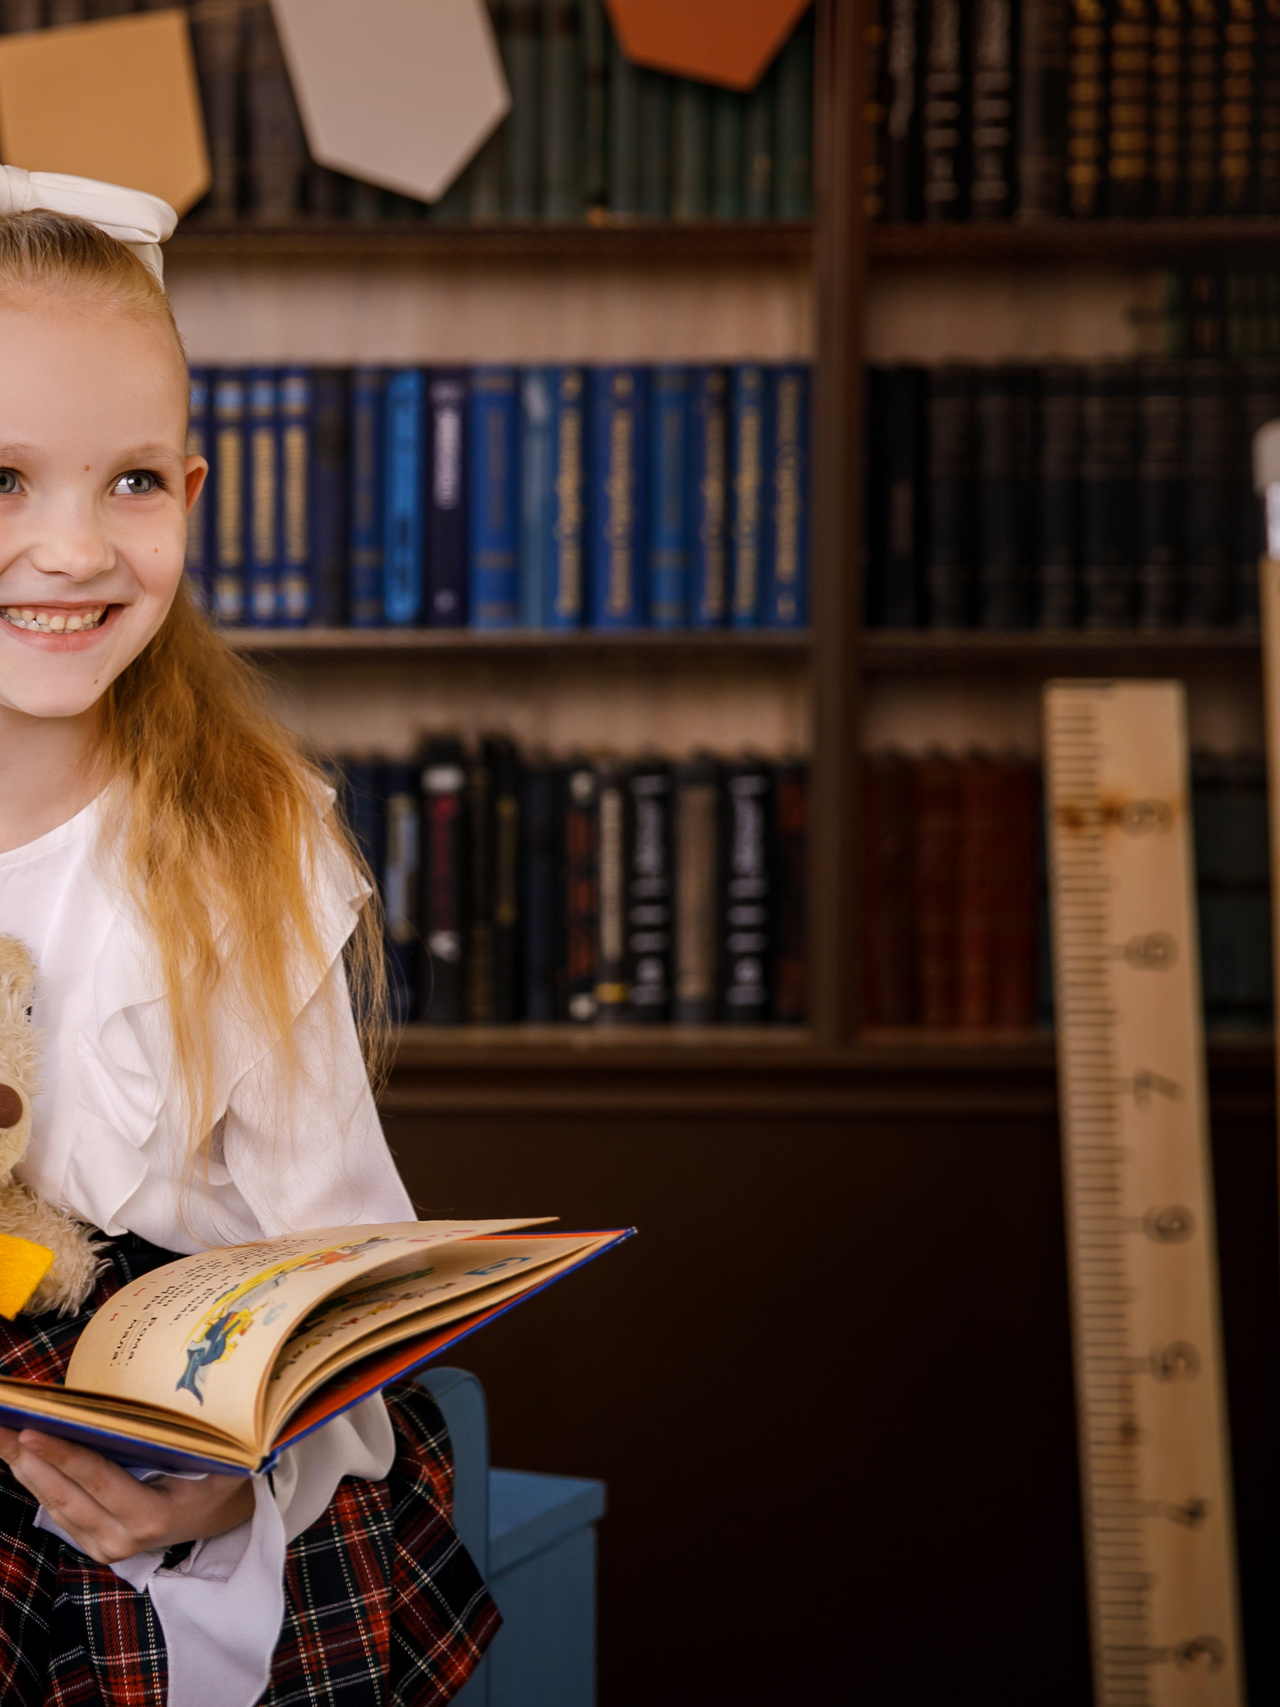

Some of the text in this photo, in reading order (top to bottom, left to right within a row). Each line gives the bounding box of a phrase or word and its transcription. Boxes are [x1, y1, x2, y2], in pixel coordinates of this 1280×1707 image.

[142, 1285, 176, 1311] Ира
[169, 1288, 213, 1326] Рома.
[185, 1282, 229, 1317] мама.
[109, 1319, 138, 1367] мала.
[125, 1316, 158, 1366] Рома.
